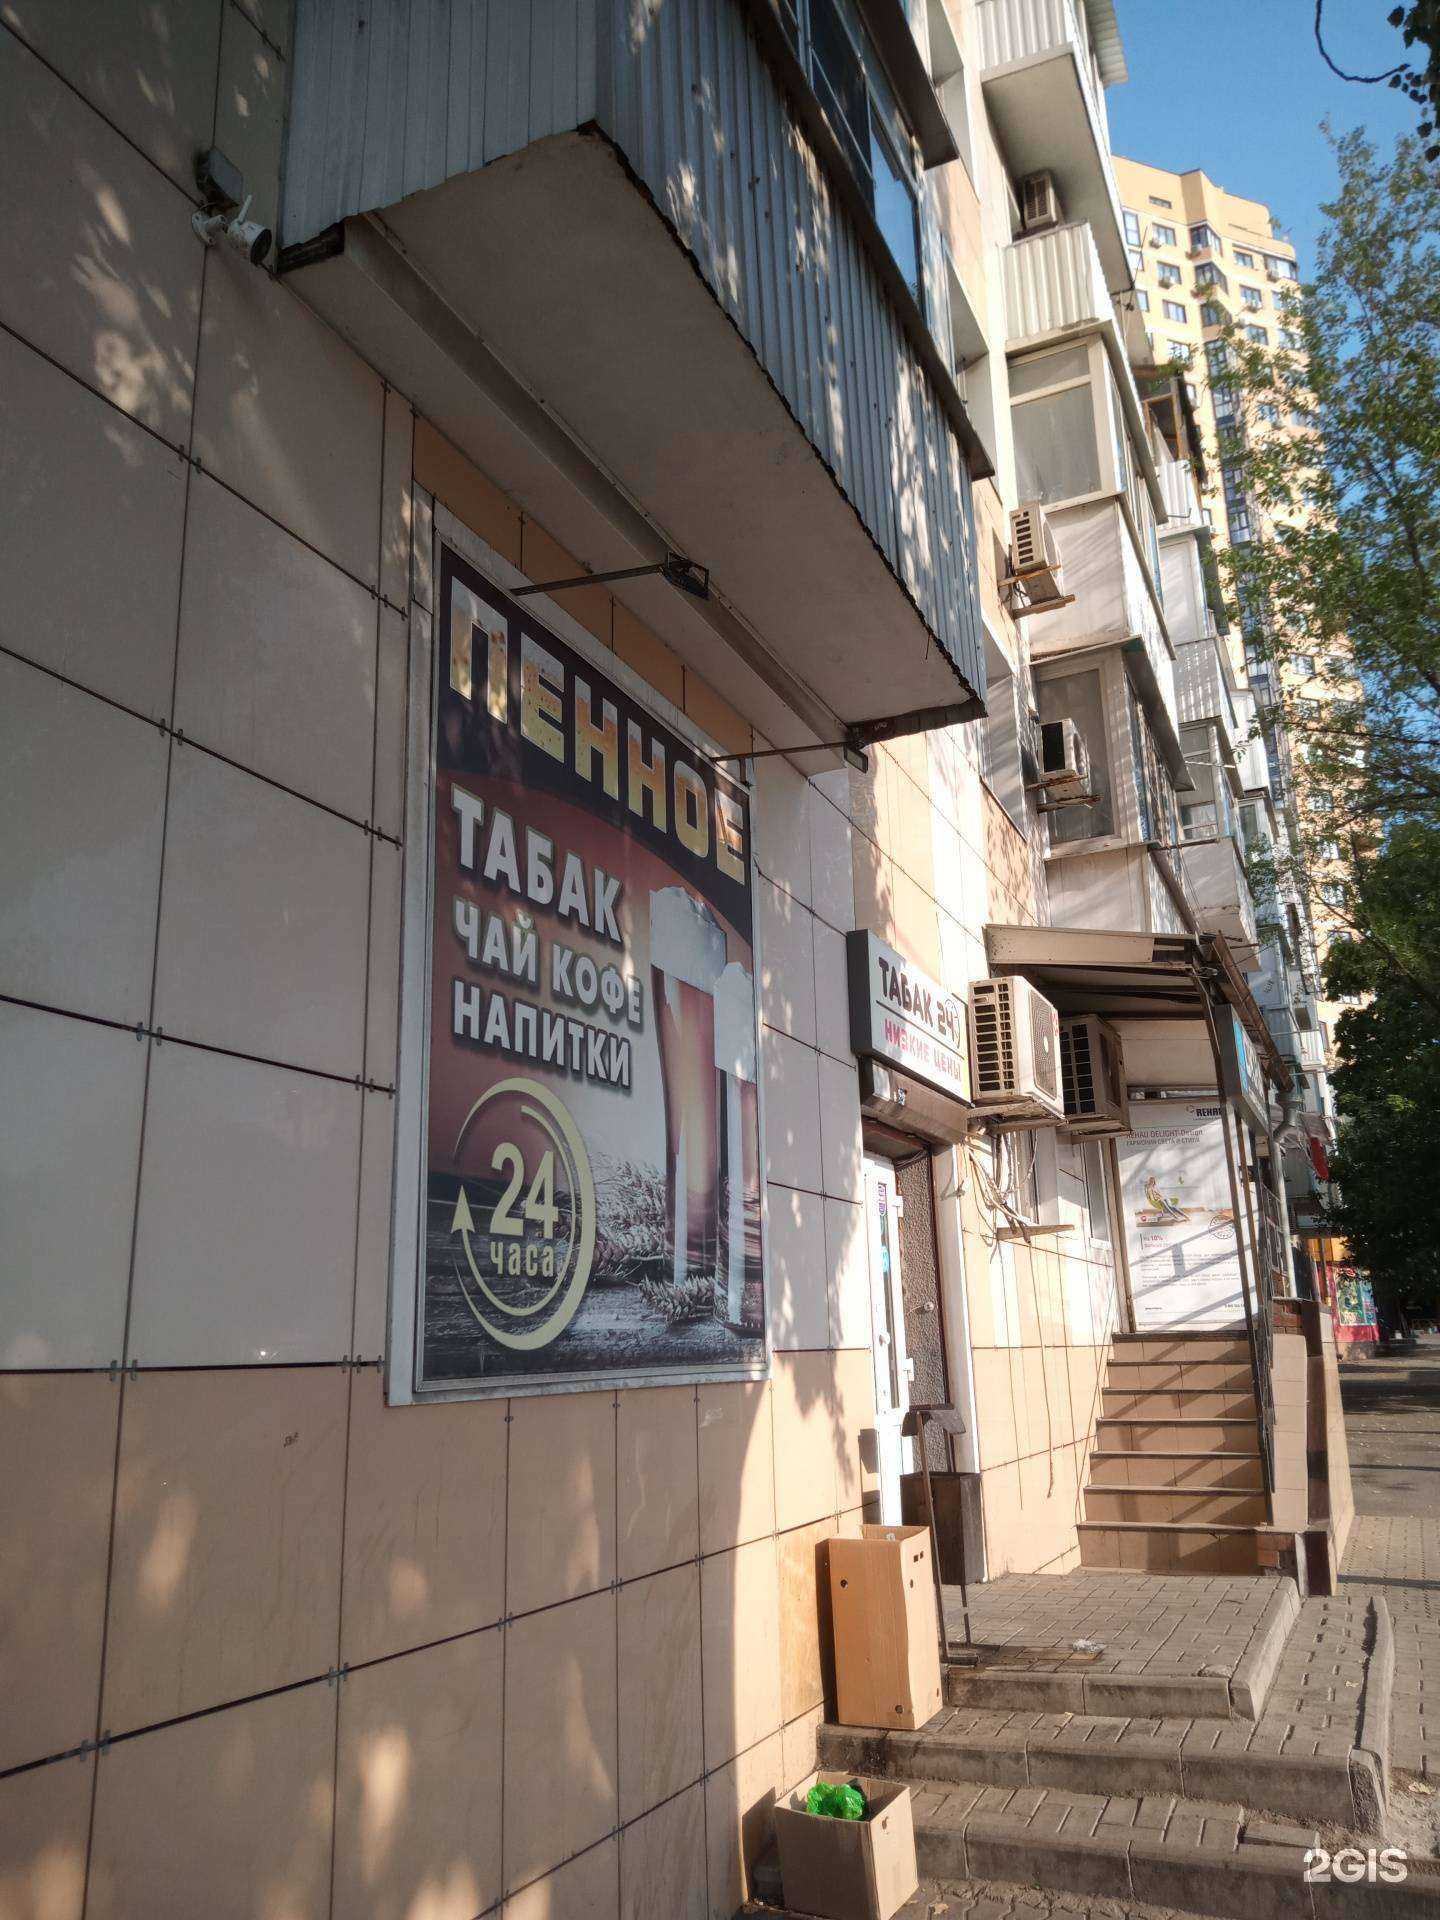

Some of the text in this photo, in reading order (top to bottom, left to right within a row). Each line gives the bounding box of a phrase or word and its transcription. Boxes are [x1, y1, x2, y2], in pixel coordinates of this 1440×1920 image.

[450, 575, 746, 886] ПЕННОЕ
[452, 786, 623, 943] ТАБАК
[454, 898, 642, 1024] ЧАЙ КОФЕ
[878, 956, 934, 1028] ТАБАК
[453, 979, 632, 1088] НАПИТКИ
[489, 1141, 559, 1239] 24
[490, 1241, 557, 1278] часа
